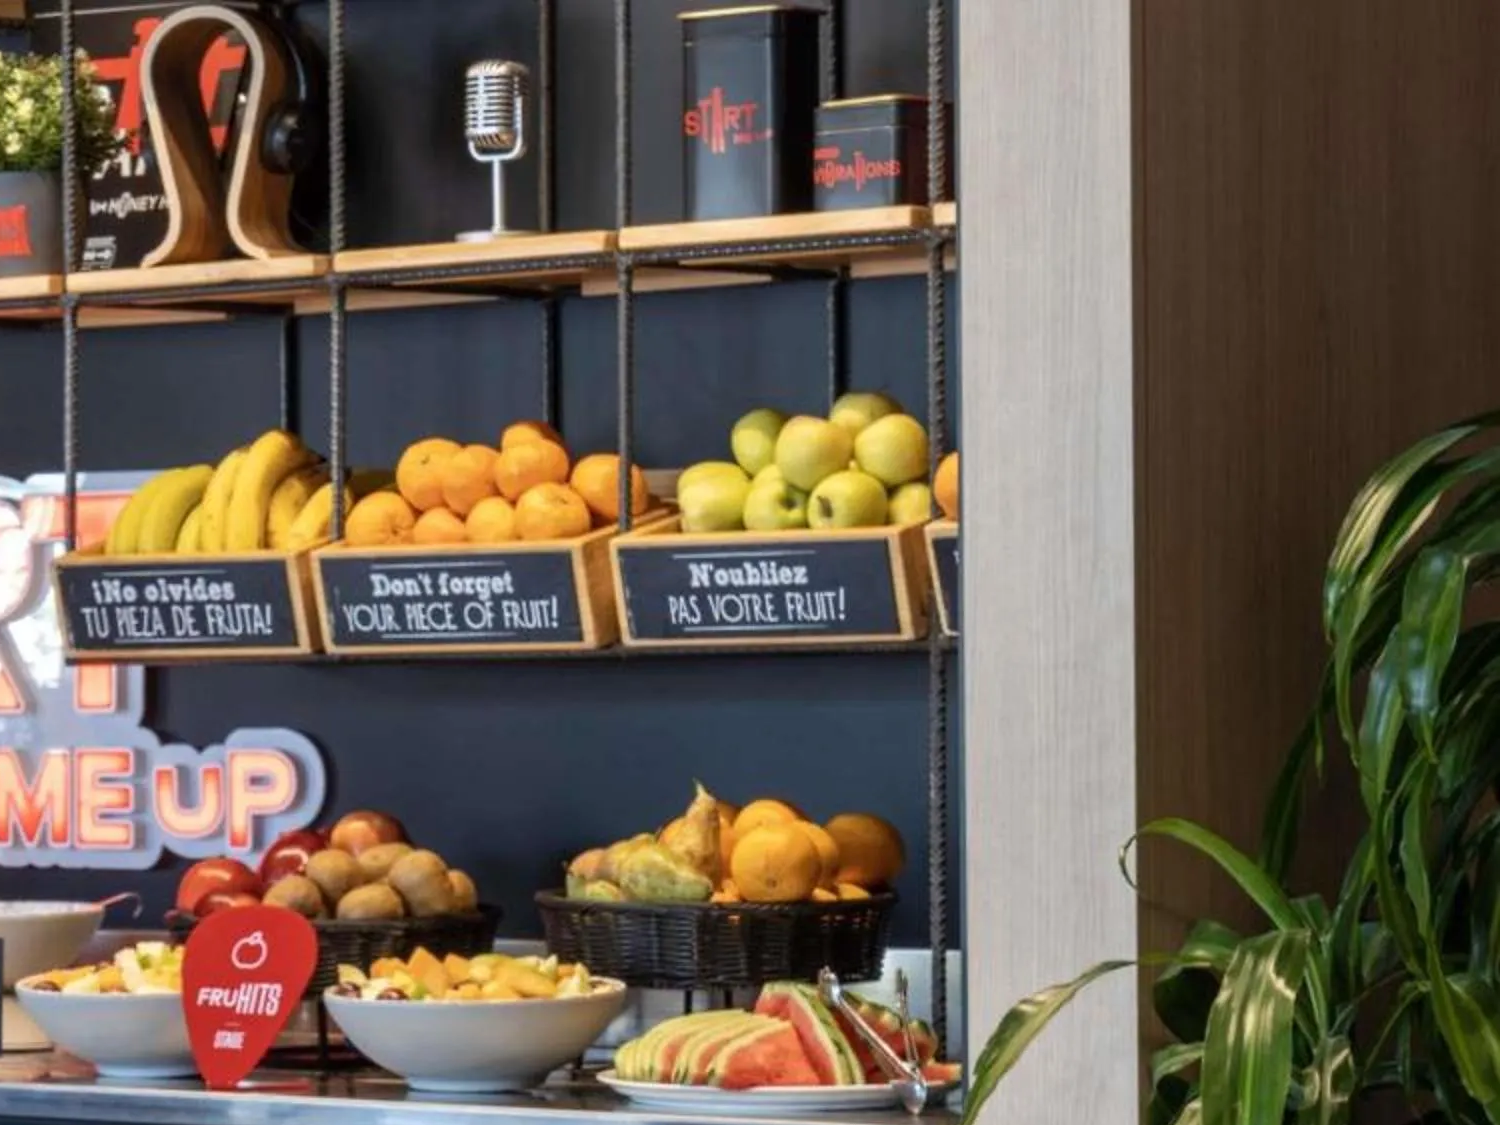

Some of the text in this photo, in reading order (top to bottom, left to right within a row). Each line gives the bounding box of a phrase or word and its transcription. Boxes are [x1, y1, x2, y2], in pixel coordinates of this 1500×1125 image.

[684, 86, 757, 153] START
[145, 577, 235, 603] olvides
[370, 571, 514, 600] Don't forget
[689, 561, 808, 588] N'oubliez
[81, 602, 273, 638] TU PIEZA DE FRUTA!
[343, 595, 559, 632] YOUR PIECE OF FRUIT!
[669, 587, 845, 624] PAS VOTRE FRUIT!
[153, 748, 299, 848] UP
[197, 982, 283, 1017] FRUHITS
